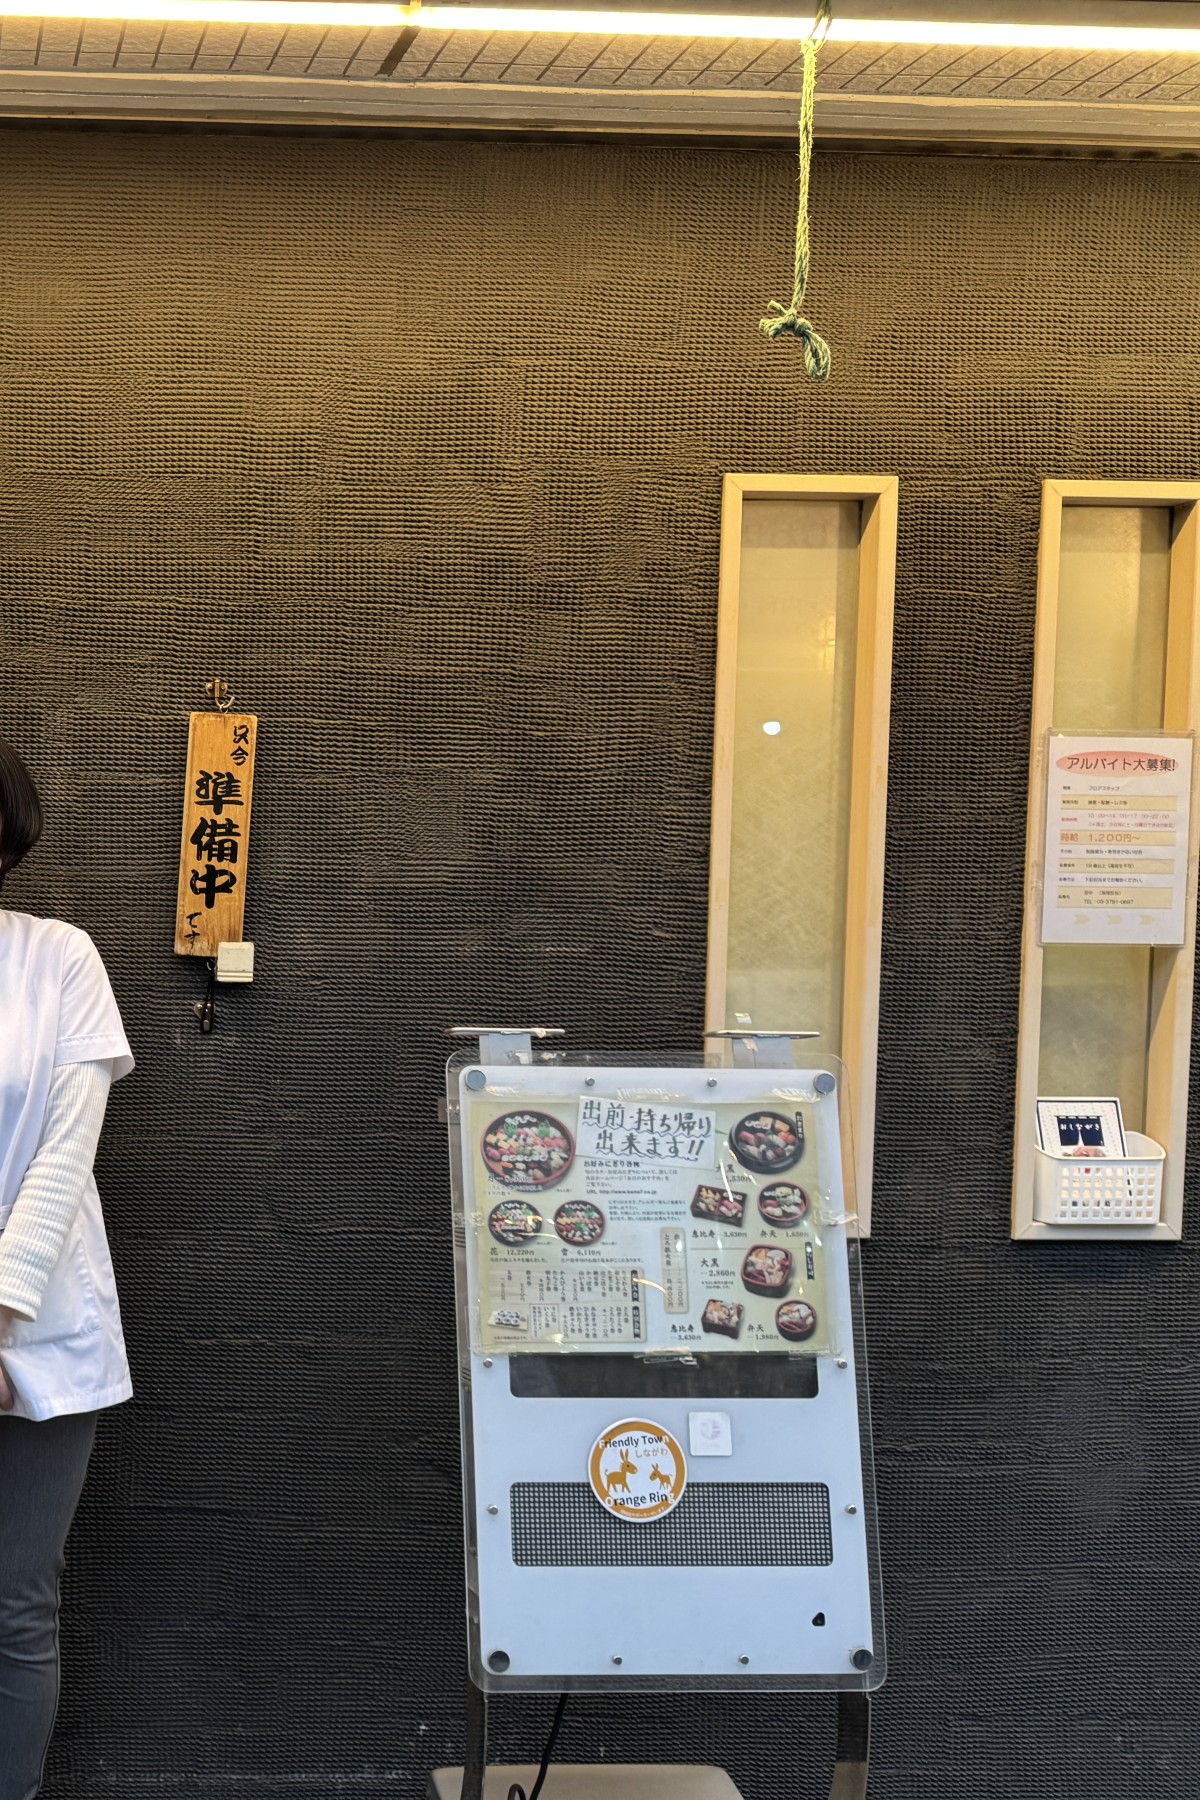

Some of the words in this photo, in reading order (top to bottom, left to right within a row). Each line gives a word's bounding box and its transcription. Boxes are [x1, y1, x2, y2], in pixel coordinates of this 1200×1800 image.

[189, 769, 244, 909] 準備中
[1060, 832, 1078, 842] 時給
[184, 911, 202, 950] です
[700, 1258, 719, 1268] 大黒
[670, 1324, 695, 1333] 恵比寿
[599, 1436, 639, 1449] Friendly
[641, 1435, 670, 1445] Town
[635, 1447, 668, 1458] しながわ
[605, 1495, 647, 1507] Orange
[649, 1491, 675, 1505] Ring
